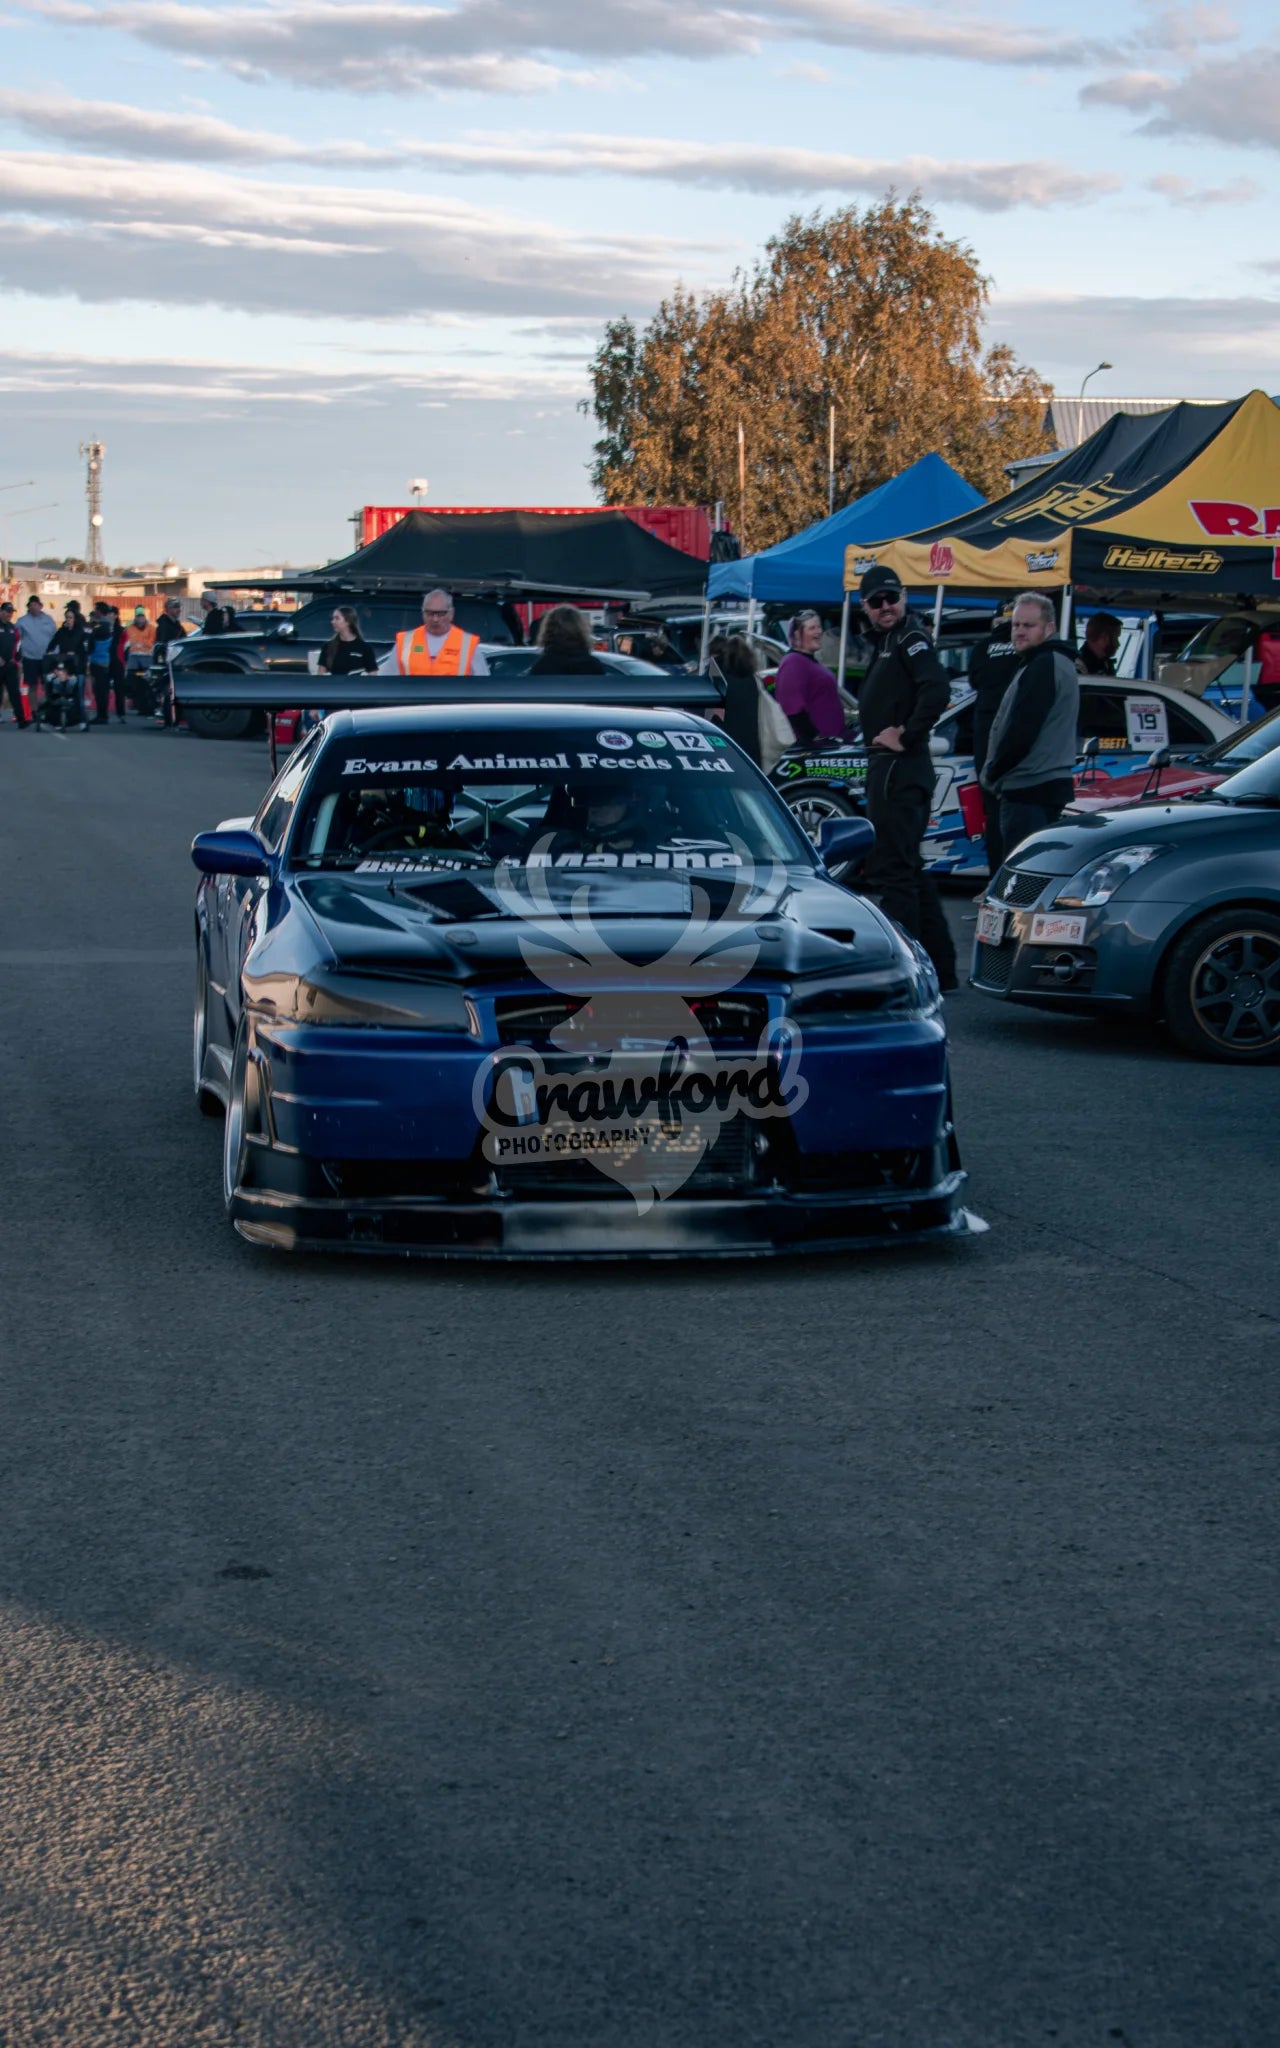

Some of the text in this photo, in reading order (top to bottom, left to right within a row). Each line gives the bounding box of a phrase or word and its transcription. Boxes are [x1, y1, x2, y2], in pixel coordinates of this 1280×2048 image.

[1105, 547, 1222, 573] Haltech
[1137, 713, 1158, 730] 19
[674, 735, 705, 749] 12
[341, 751, 735, 776] Evans Animal Feeds Ltd
